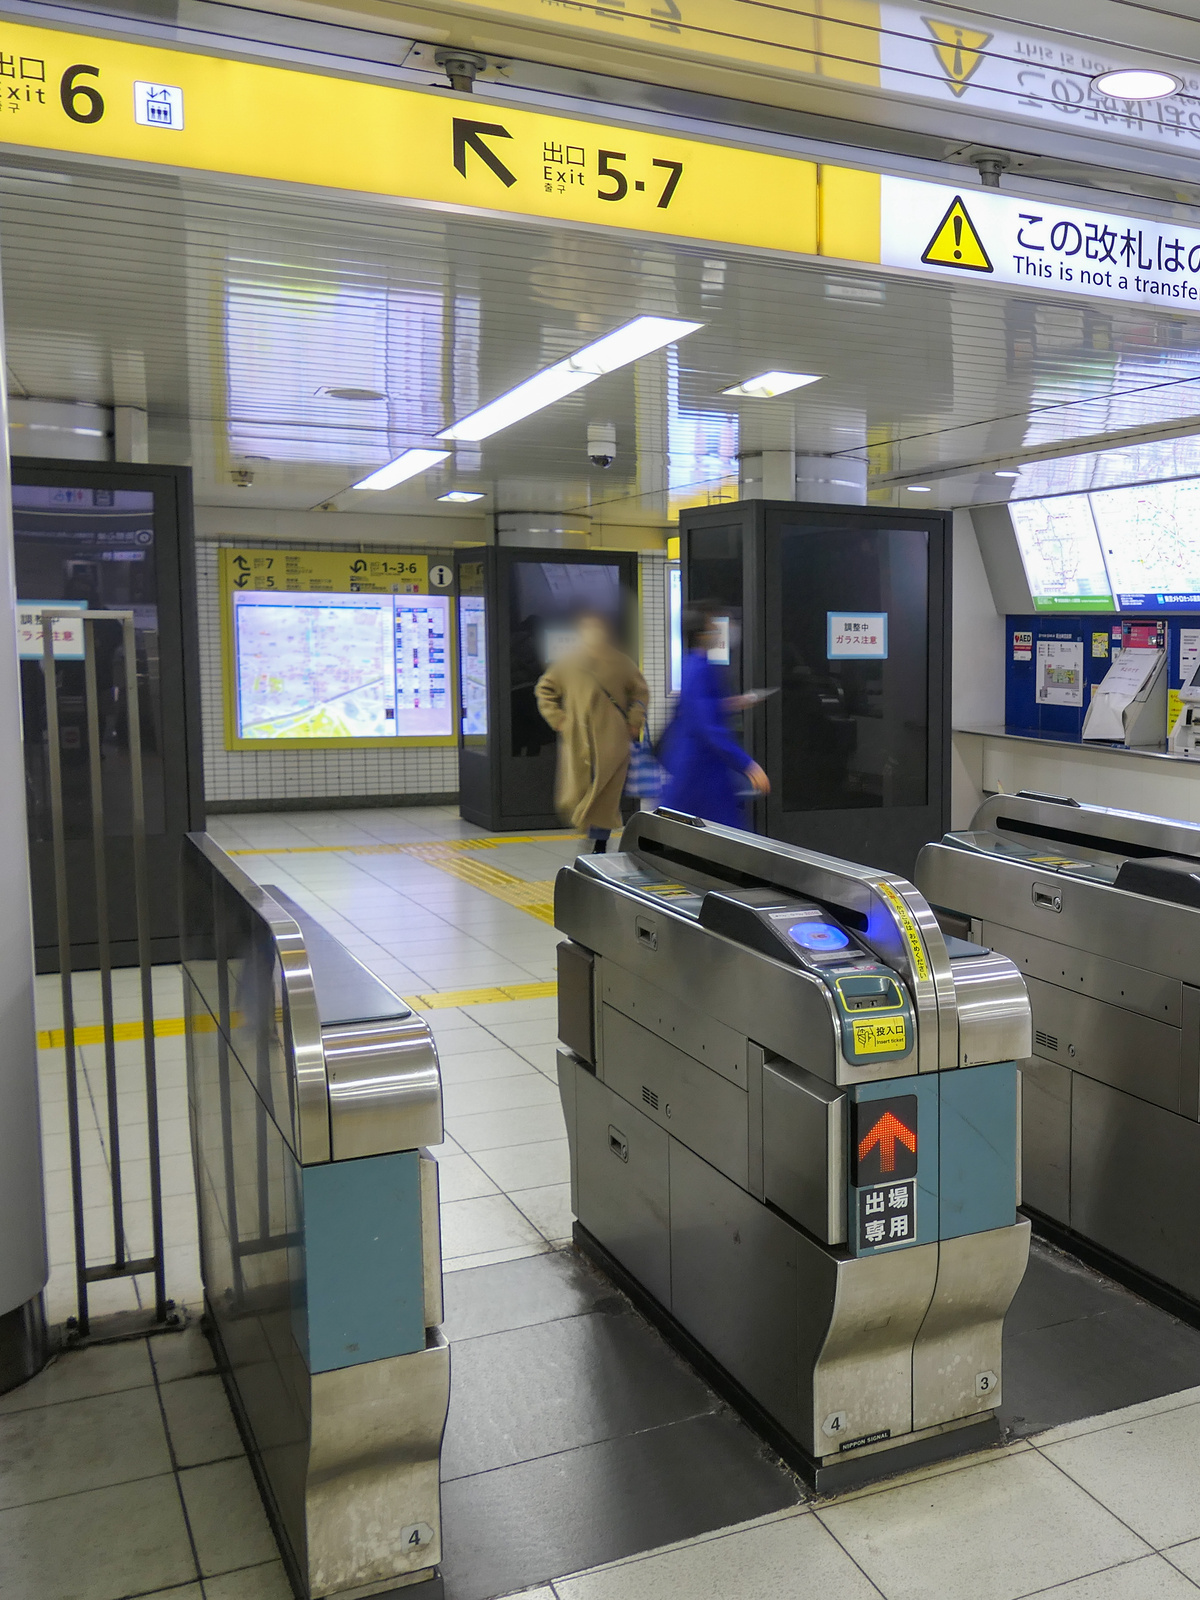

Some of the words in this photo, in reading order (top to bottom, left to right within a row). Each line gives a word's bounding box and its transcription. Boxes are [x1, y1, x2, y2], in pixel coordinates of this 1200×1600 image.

[0, 81, 46, 104] xit
[60, 64, 105, 124] 6
[543, 141, 585, 167] 出口
[543, 166, 585, 186] Exit
[1013, 254, 1053, 279] This
[1058, 260, 1073, 282] is
[1079, 264, 1114, 289] not
[1117, 273, 1129, 290] a
[265, 558, 274, 569] 7
[266, 576, 275, 587] 5
[844, 622, 869, 632] 調整中
[836, 635, 877, 645] ガラス注意
[1020, 634, 1031, 642] AED
[876, 1025, 903, 1037] 投入口
[865, 1186, 909, 1214] 出場
[865, 1215, 909, 1242] 専用
[980, 1377, 989, 1390] 3
[830, 1417, 840, 1431] 4
[843, 1438, 866, 1450] NIPPON
[866, 1432, 888, 1445] SIGNAL
[408, 1529, 421, 1546] 4
